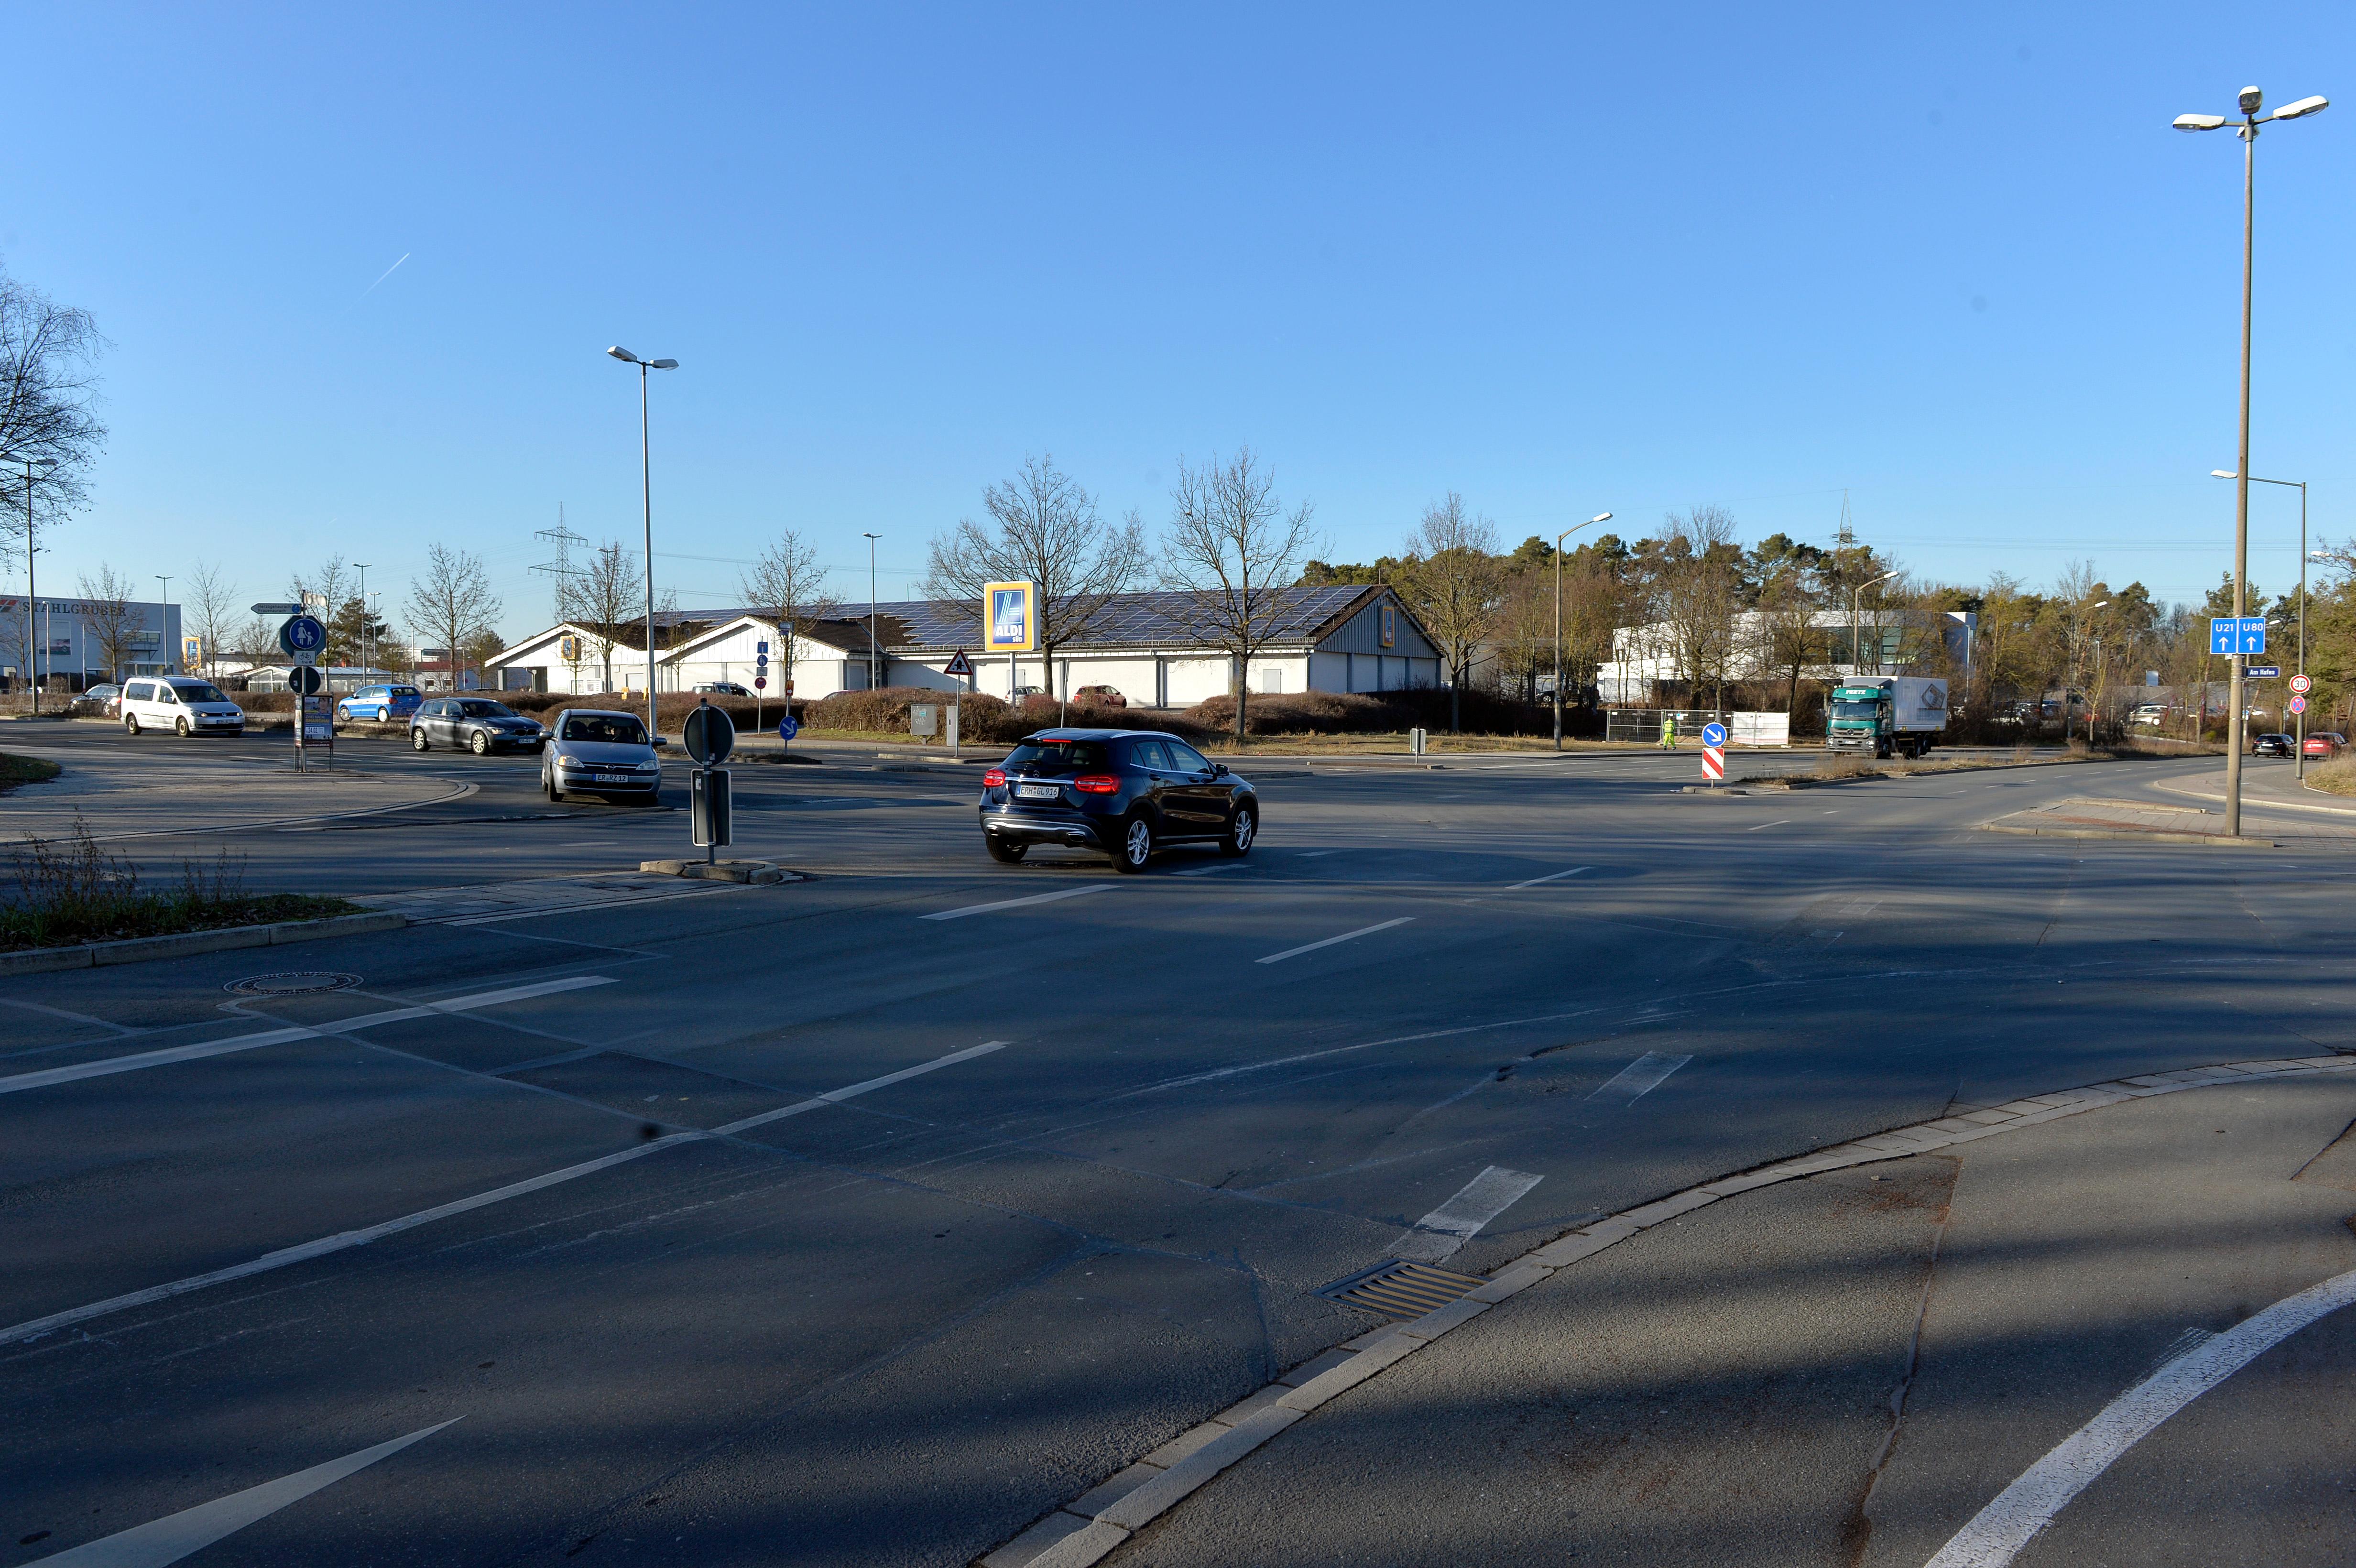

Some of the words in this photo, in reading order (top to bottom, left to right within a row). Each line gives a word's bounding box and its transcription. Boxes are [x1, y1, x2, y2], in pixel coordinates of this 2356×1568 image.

[23, 602, 126, 616] STAHLGRUBER
[995, 625, 1023, 636] ALDI
[1046, 788, 1057, 796] 916
